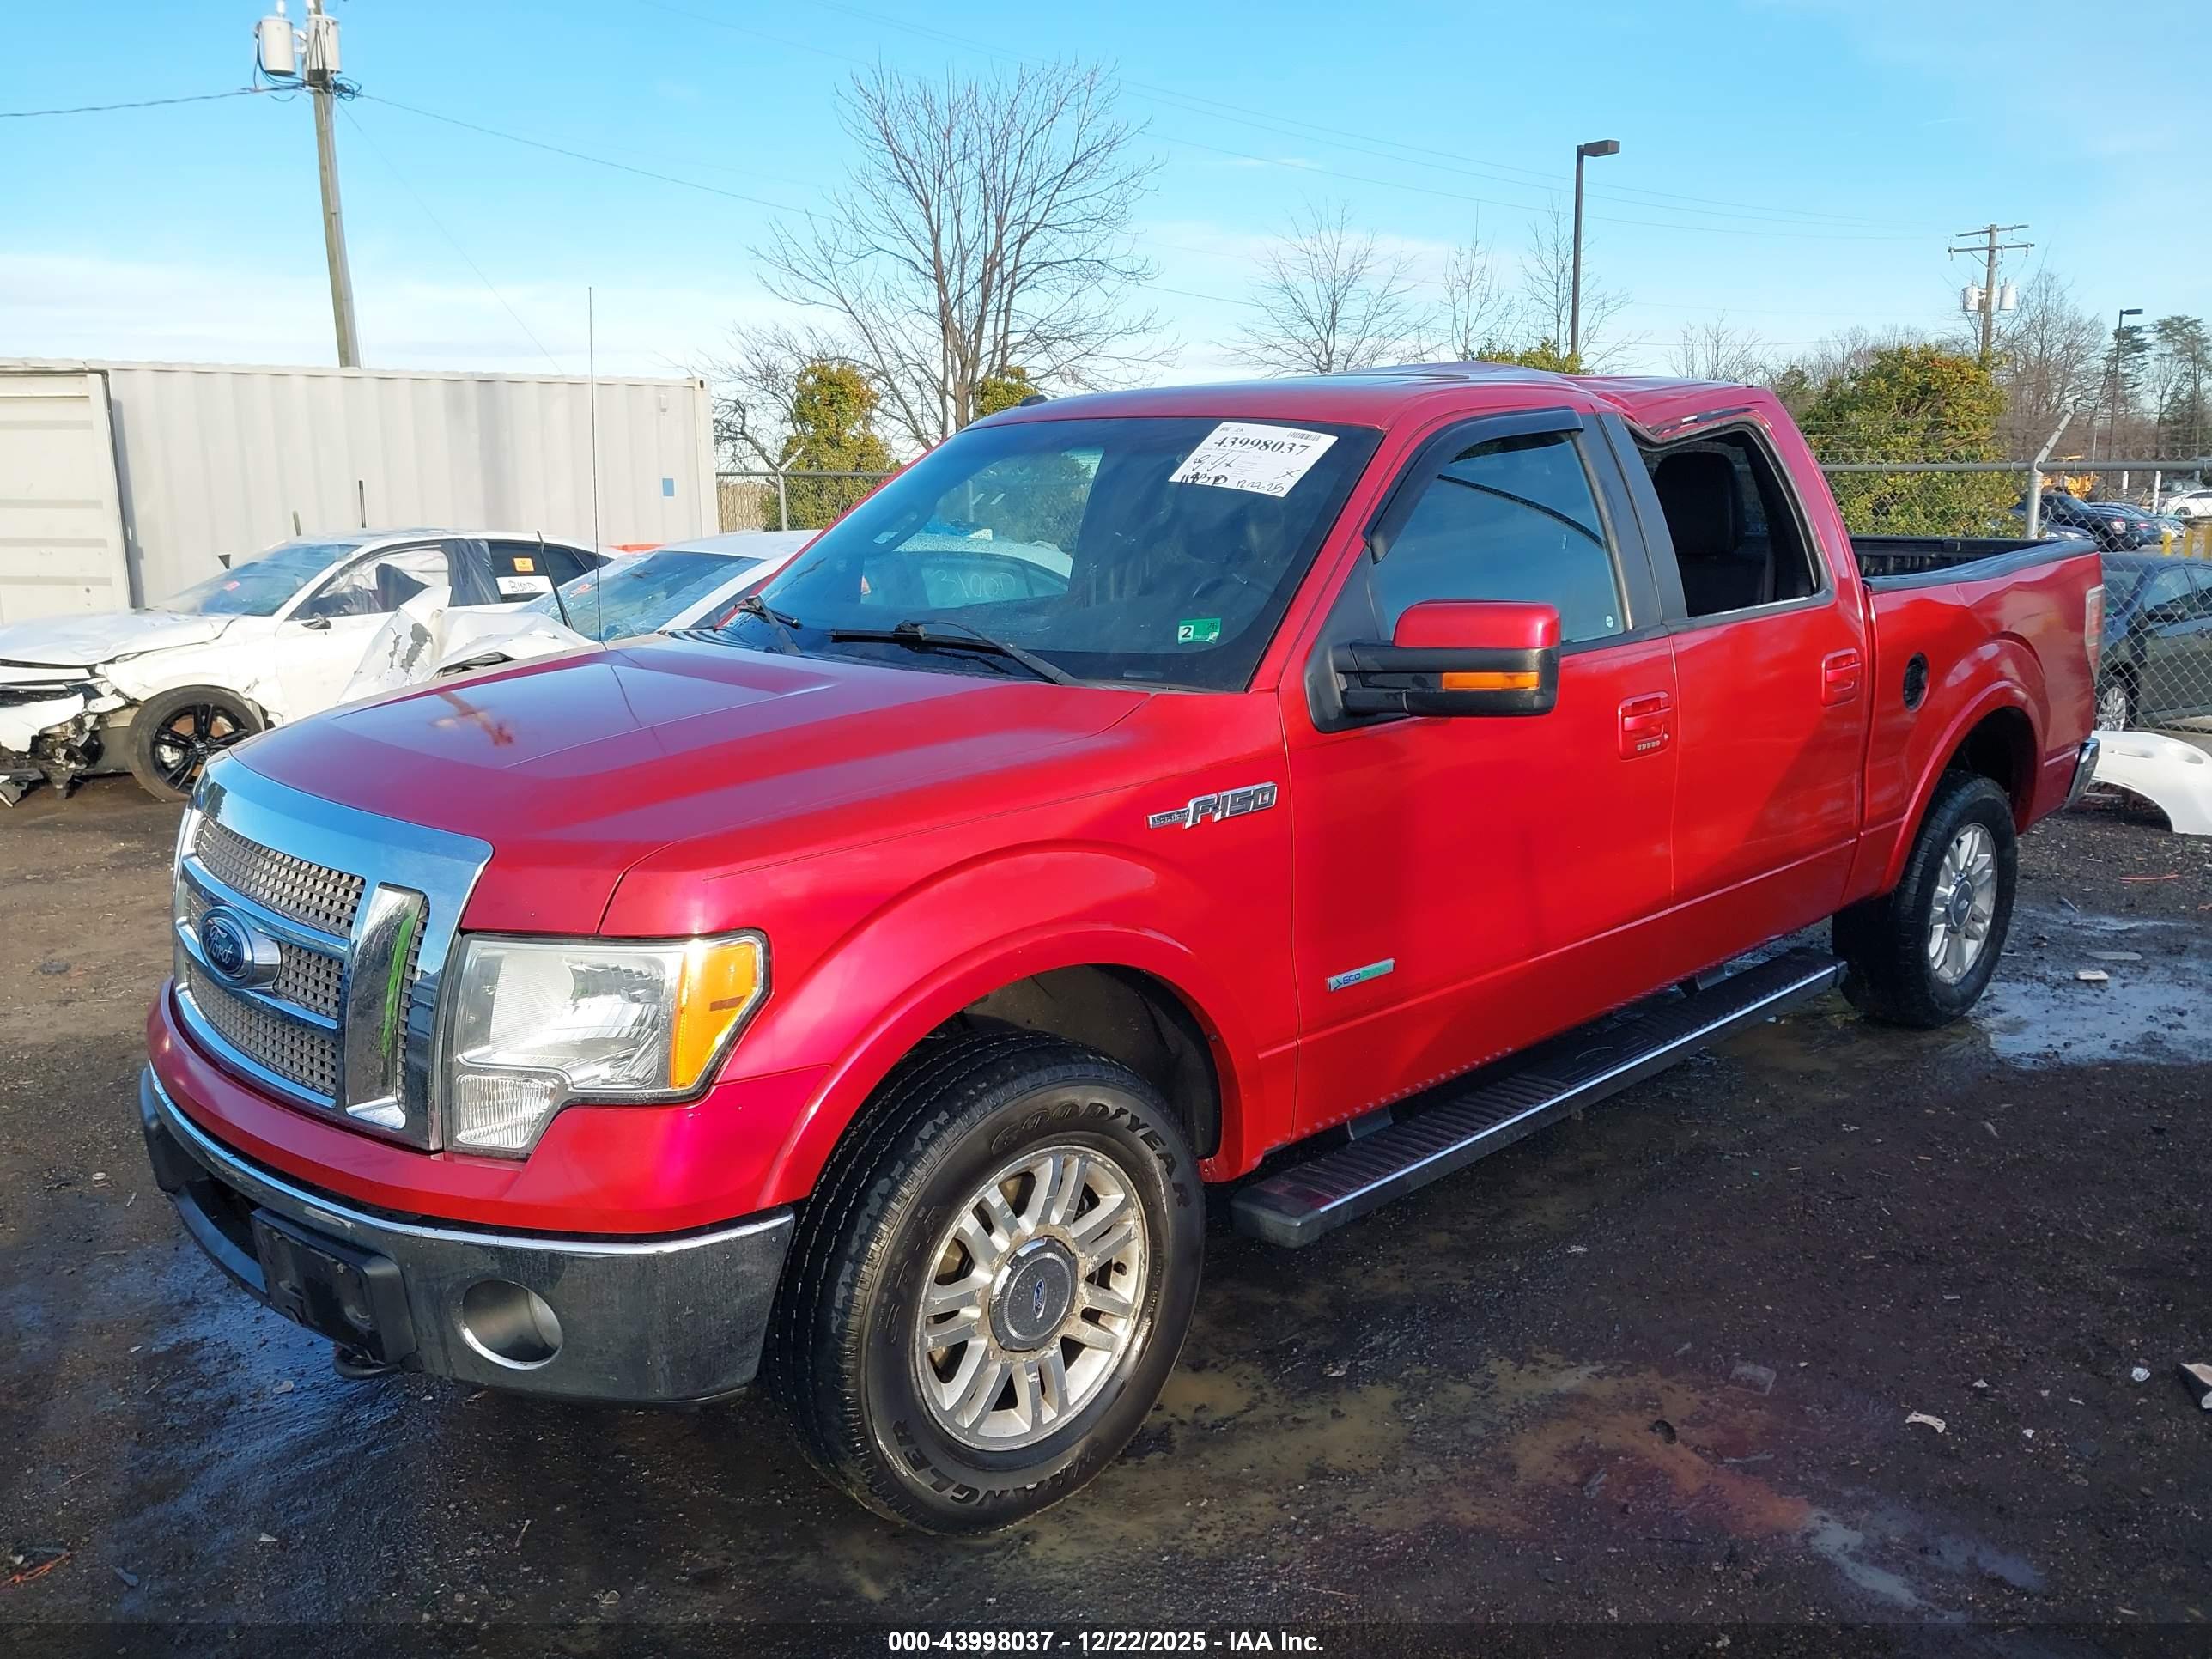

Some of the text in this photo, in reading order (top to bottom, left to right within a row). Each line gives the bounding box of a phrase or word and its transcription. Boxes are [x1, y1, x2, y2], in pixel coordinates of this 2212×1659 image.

[1213, 435, 1311, 456] 43998037
[1181, 626, 1192, 639] 2
[1182, 781, 1278, 830] F-150
[206, 925, 234, 965] Ford
[991, 1102, 1191, 1208] GOODYEAR
[891, 1419, 1080, 1507] ANGLER
